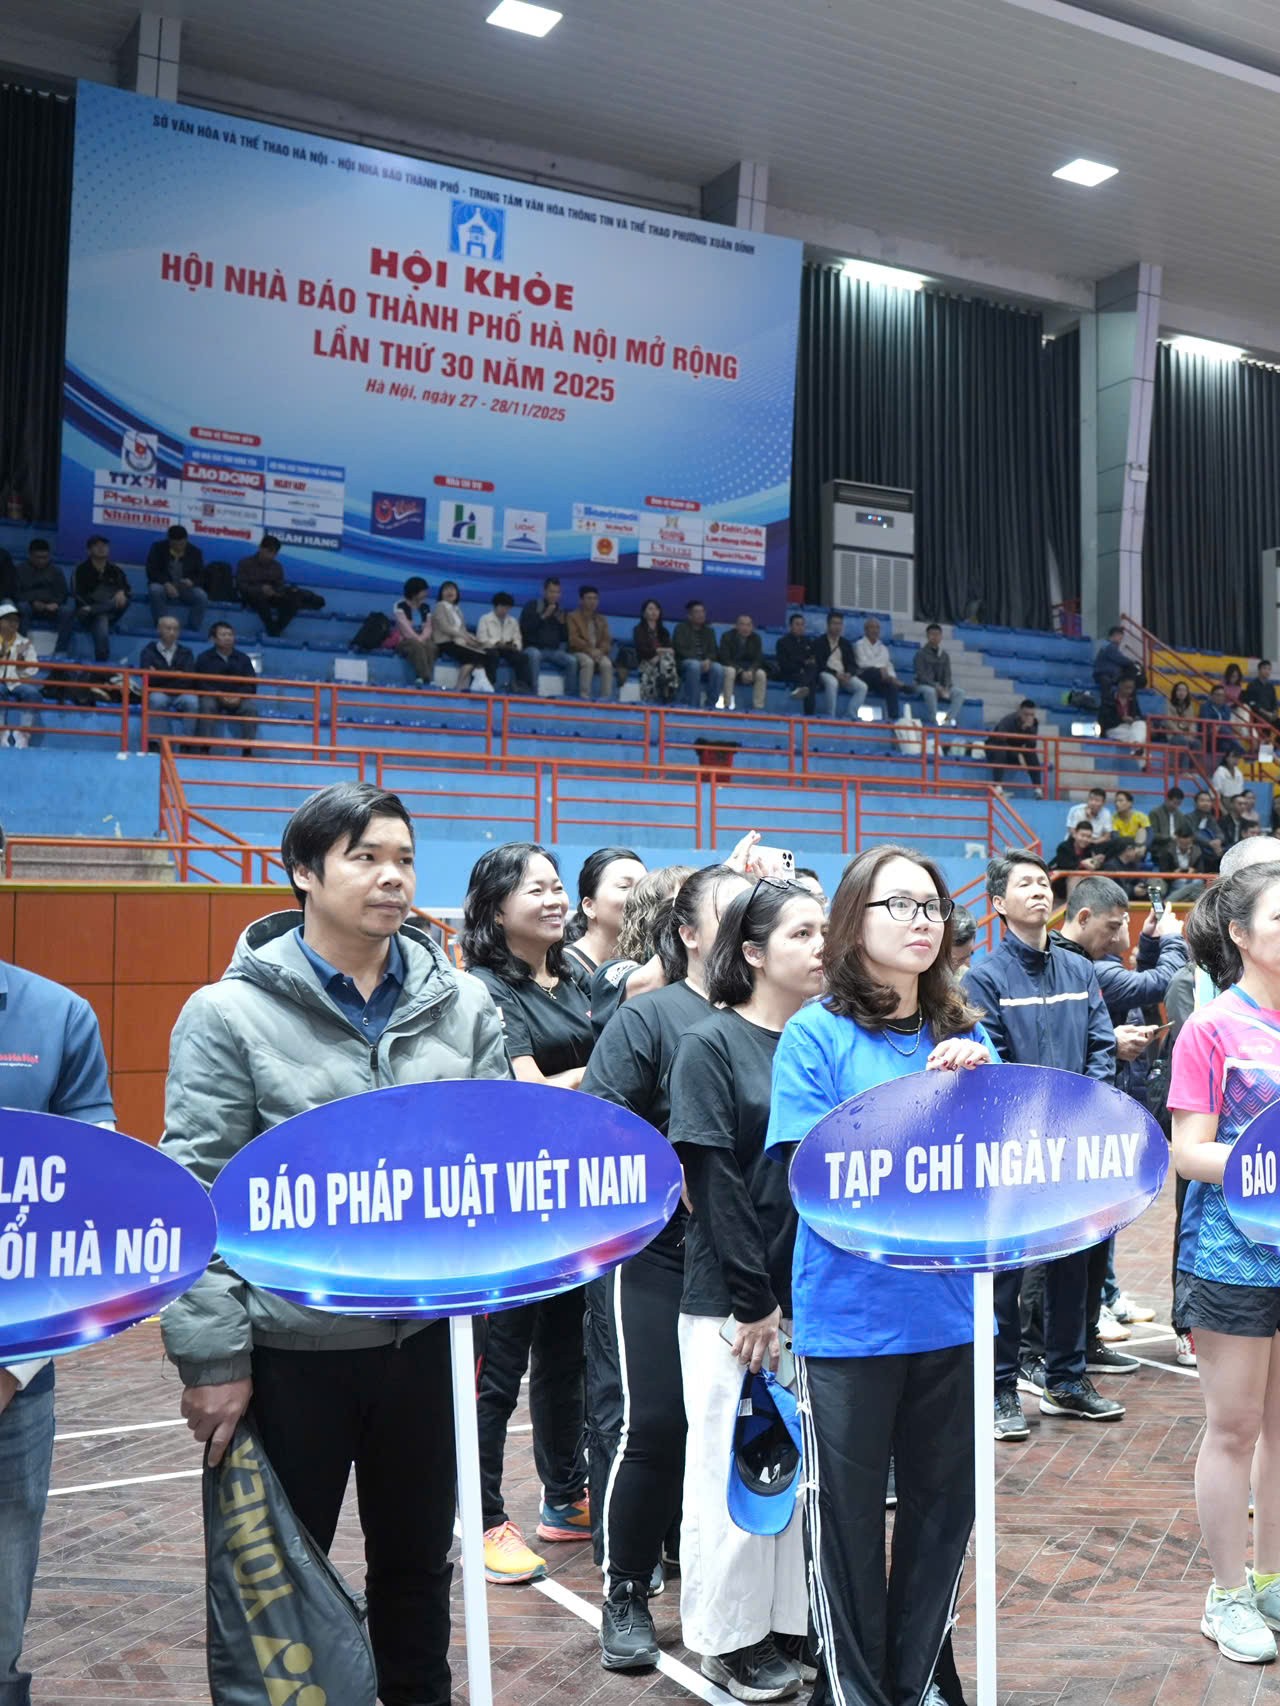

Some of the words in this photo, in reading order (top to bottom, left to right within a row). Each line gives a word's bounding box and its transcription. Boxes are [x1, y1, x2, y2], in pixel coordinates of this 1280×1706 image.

[171, 118, 194, 134] VĂN
[223, 129, 236, 145] VÀ
[263, 140, 290, 157] THAO
[292, 145, 307, 160] HÀ
[309, 150, 328, 167] NỘI
[469, 186, 500, 203] TRUNG
[599, 213, 614, 227] TIN
[648, 224, 670, 239] THAO
[161, 251, 214, 292] HỘI
[224, 264, 288, 302] NHÀ
[297, 278, 356, 315] BÁO
[366, 292, 458, 333] THÀNH
[467, 309, 522, 344] PHỐ
[530, 320, 565, 352] HÀ
[573, 327, 617, 364] NỘI
[625, 335, 666, 368] MỞ
[672, 345, 738, 380] RỘNG
[370, 247, 448, 292] HỘI
[464, 266, 574, 312] KHỎE
[313, 324, 370, 364] LẦN
[379, 342, 436, 374] THỨ
[440, 351, 474, 381] 30
[482, 356, 545, 392] NĂM
[553, 370, 615, 403] 2025
[365, 378, 385, 395] Hà
[422, 387, 456, 407] ngày
[458, 393, 478, 408] 27
[490, 398, 566, 422] 28/11/2025
[187, 465, 217, 481] LAO
[0, 1155, 66, 1213] LẠC
[248, 1163, 316, 1233] BÁO
[327, 1158, 413, 1226] PHÁP
[423, 1153, 498, 1227] LUẬT
[505, 1148, 570, 1222] VIỆT
[578, 1154, 646, 1208] NAM
[824, 1149, 893, 1209] TẠP
[905, 1133, 965, 1194] CHÍ
[975, 1129, 1066, 1189] NGÀY
[1076, 1133, 1140, 1182] NAY
[1241, 1143, 1277, 1198] BÁO
[50, 1219, 102, 1278] HÀ
[115, 1218, 181, 1284] NỘI
[219, 1437, 293, 1624] YONEX
